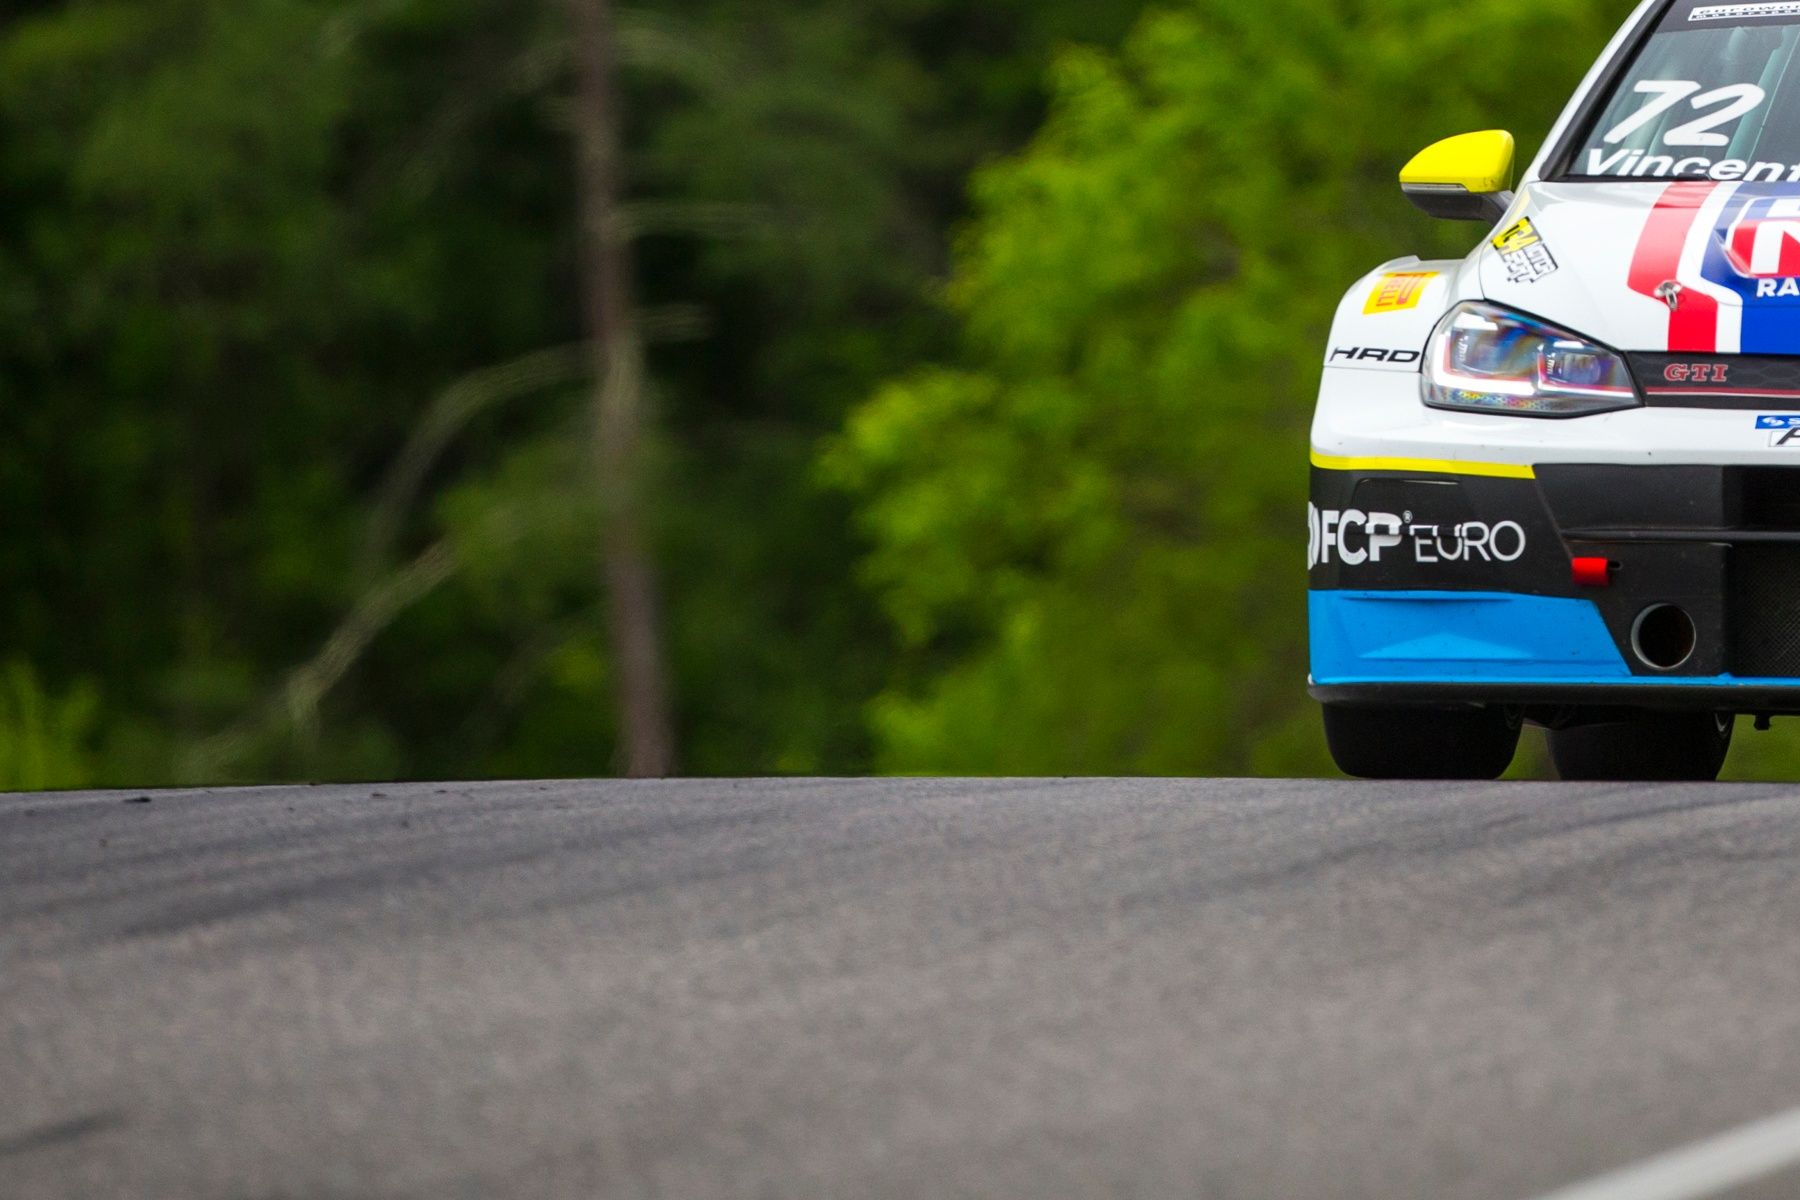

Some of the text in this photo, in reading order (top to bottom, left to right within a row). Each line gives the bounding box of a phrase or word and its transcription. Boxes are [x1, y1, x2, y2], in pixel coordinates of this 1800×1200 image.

[1603, 80, 1766, 147] 72
[1329, 347, 1420, 363] HRD
[1663, 363, 1729, 382] GTI
[1409, 520, 1526, 563] EURO
